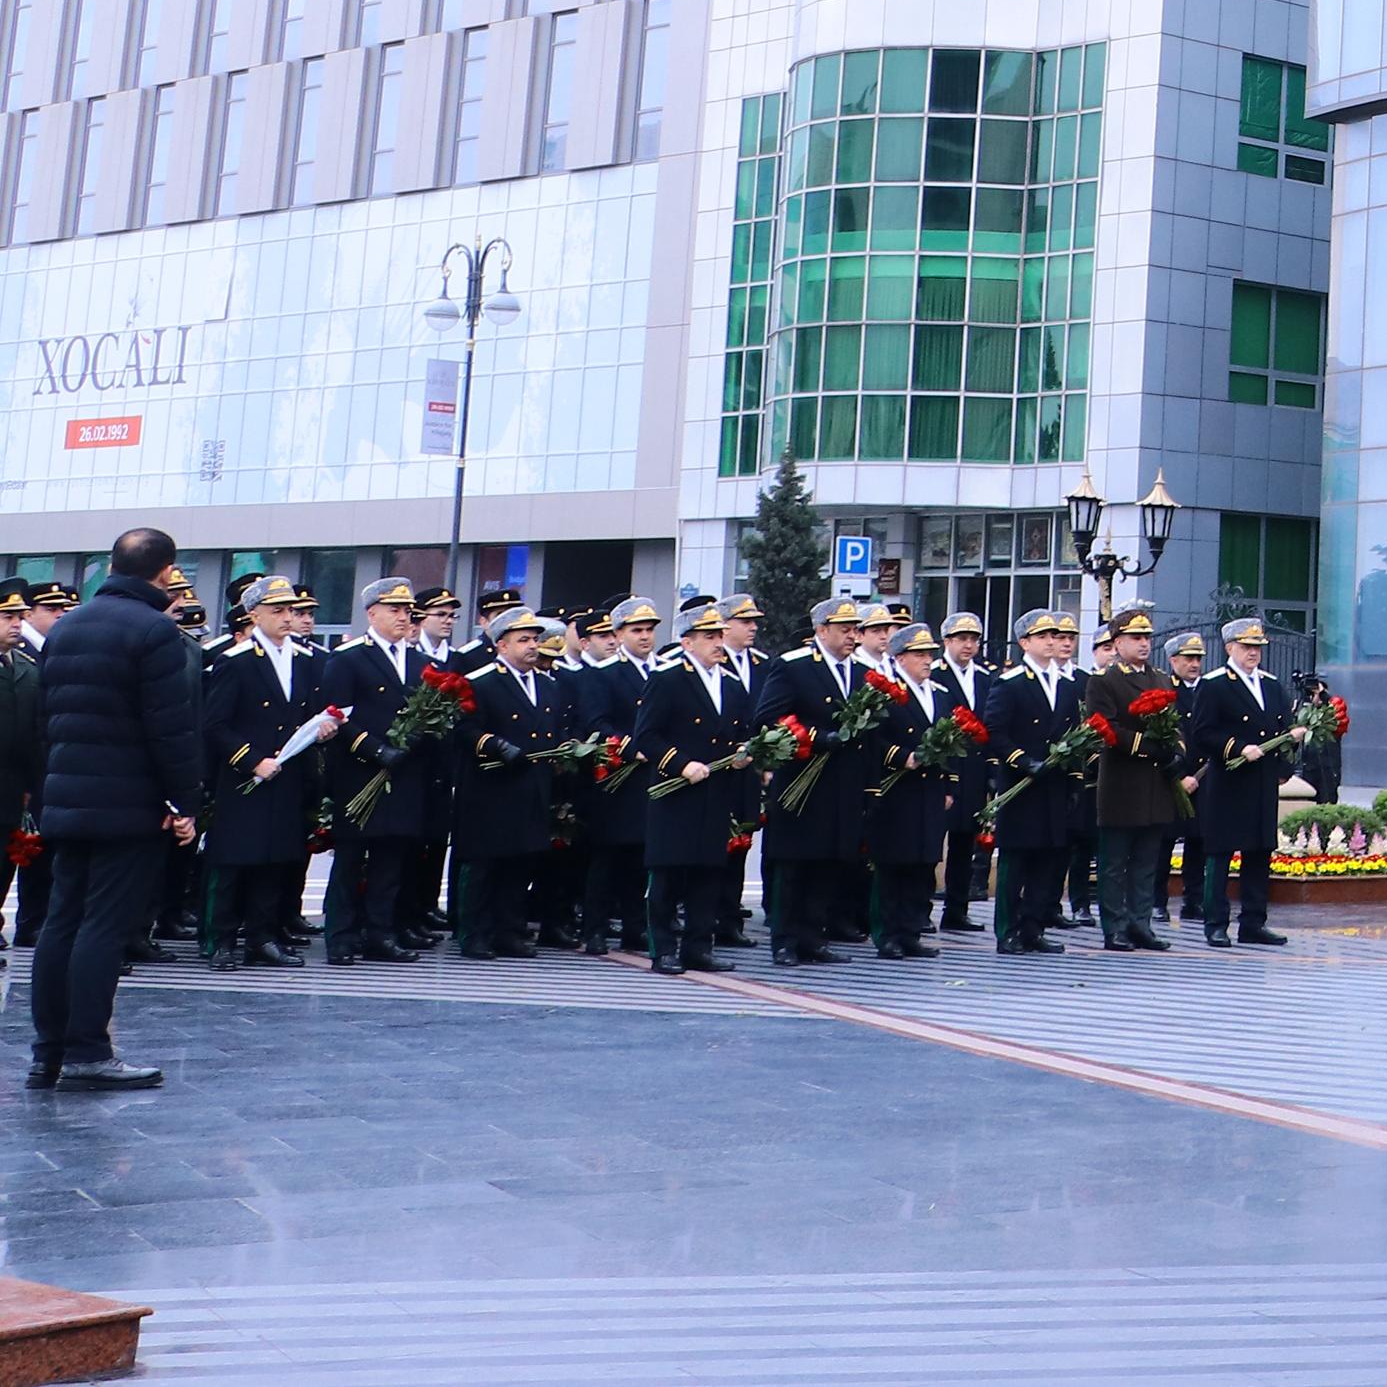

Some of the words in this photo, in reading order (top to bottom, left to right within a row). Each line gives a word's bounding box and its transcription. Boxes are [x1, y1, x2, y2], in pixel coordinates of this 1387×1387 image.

[32, 325, 192, 396] XOCALI
[78, 423, 128, 442] 26.02.1992
[846, 541, 865, 571] P
